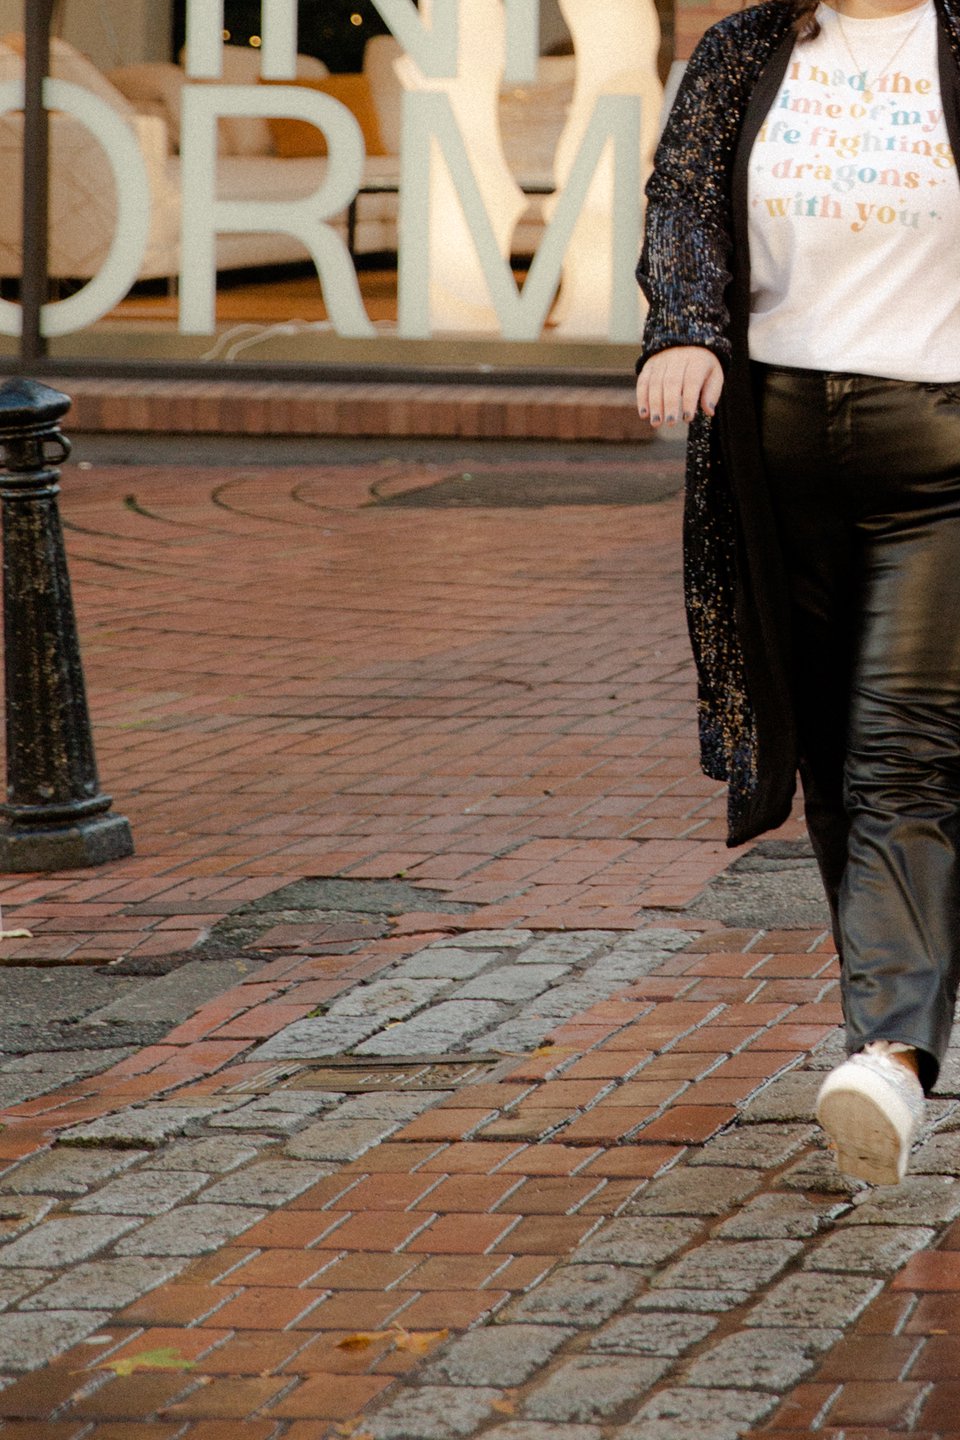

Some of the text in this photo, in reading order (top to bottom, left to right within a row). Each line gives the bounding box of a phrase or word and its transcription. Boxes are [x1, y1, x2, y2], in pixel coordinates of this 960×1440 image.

[789, 62, 932, 95] I had the
[780, 89, 843, 119] ime
[890, 109, 943, 133] my
[757, 120, 957, 169] ife fighting
[771, 158, 921, 193] dragons
[764, 191, 921, 233] with you
